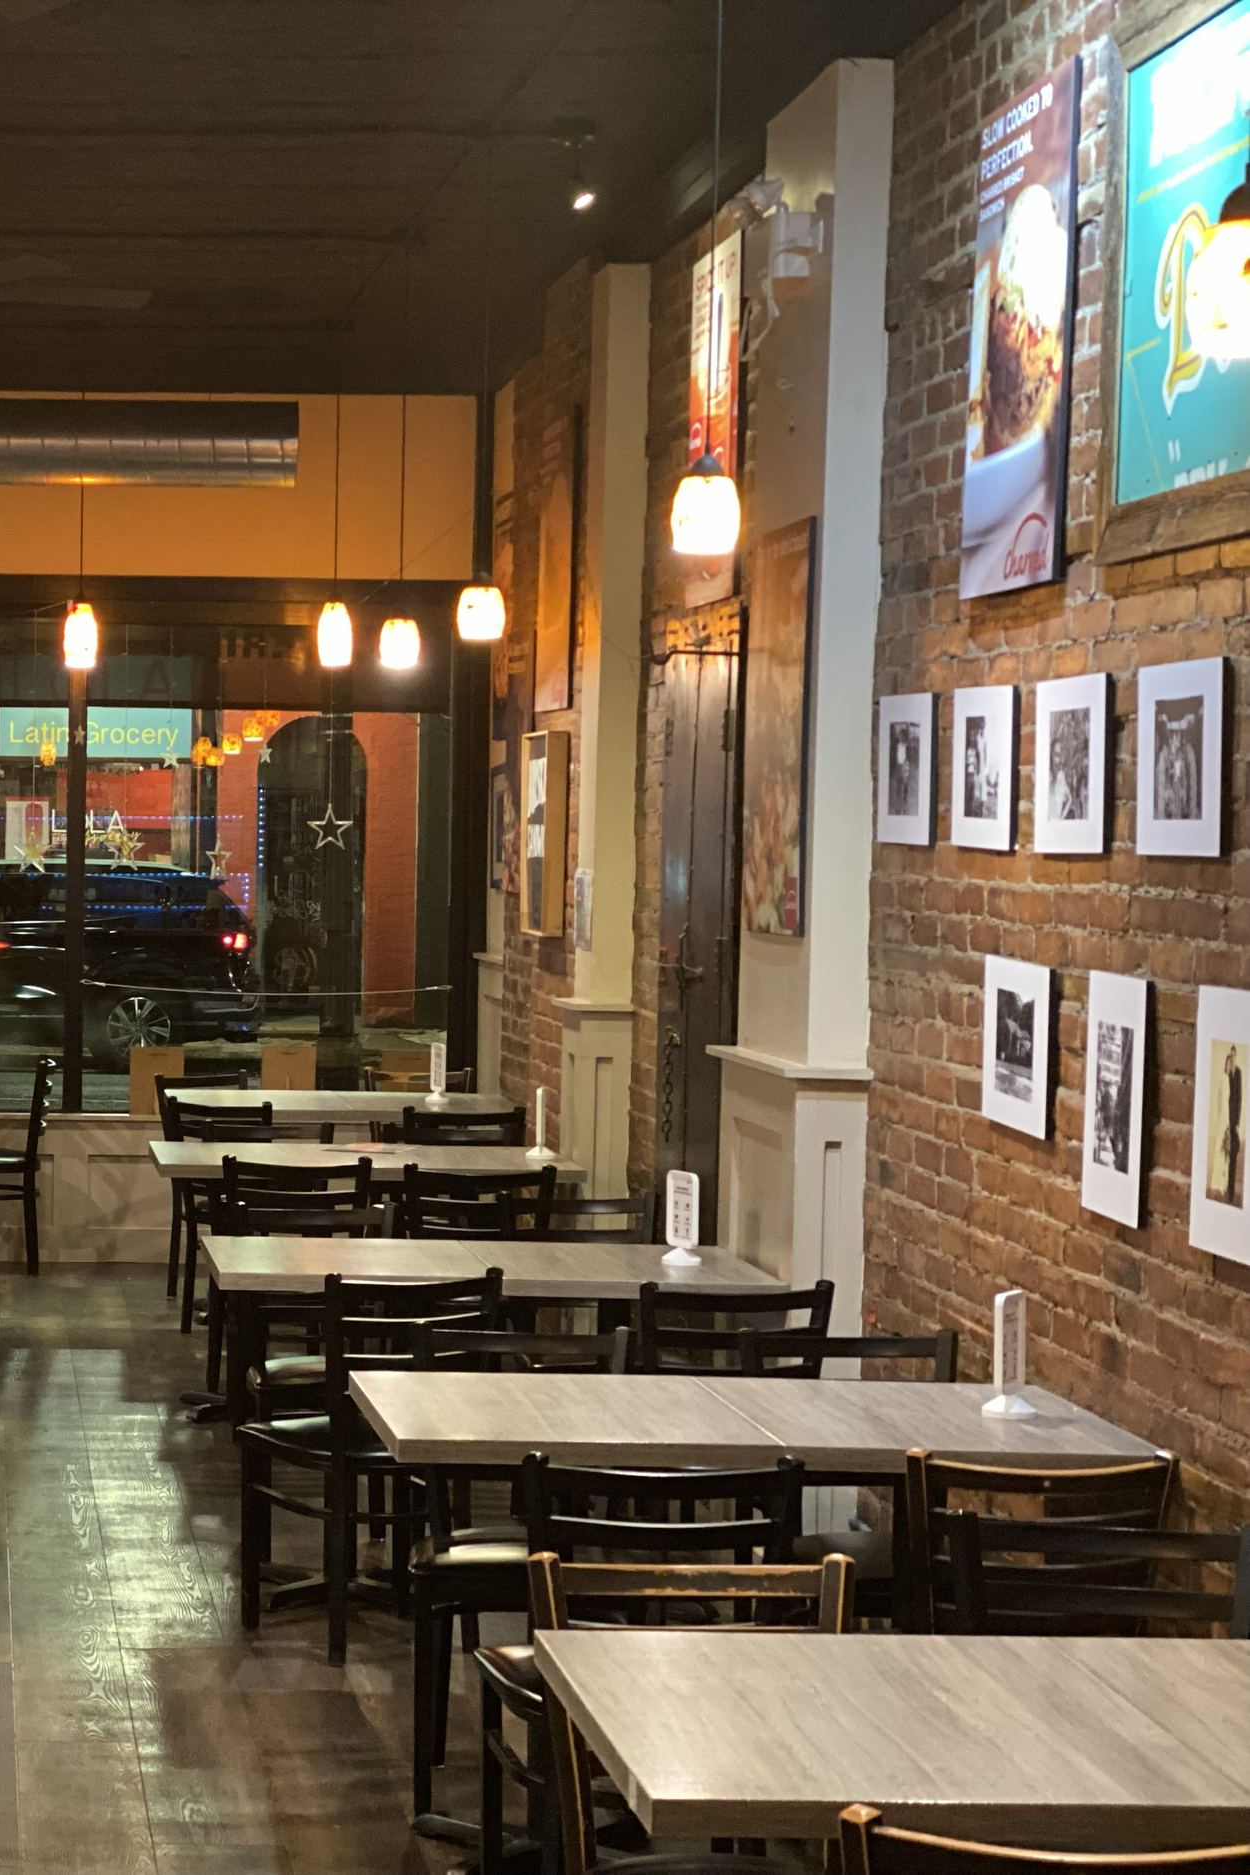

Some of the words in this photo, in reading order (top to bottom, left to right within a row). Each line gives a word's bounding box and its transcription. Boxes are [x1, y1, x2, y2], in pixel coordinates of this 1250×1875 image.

[981, 116, 1005, 150] SLOW
[1006, 92, 1039, 134] COOKED
[1040, 82, 1053, 110] TO
[981, 130, 1033, 182] PERFECTION.
[1003, 512, 1050, 580] Charred
[9, 721, 69, 744] Latin
[87, 722, 178, 747] Grocery
[52, 809, 124, 834] LLA
